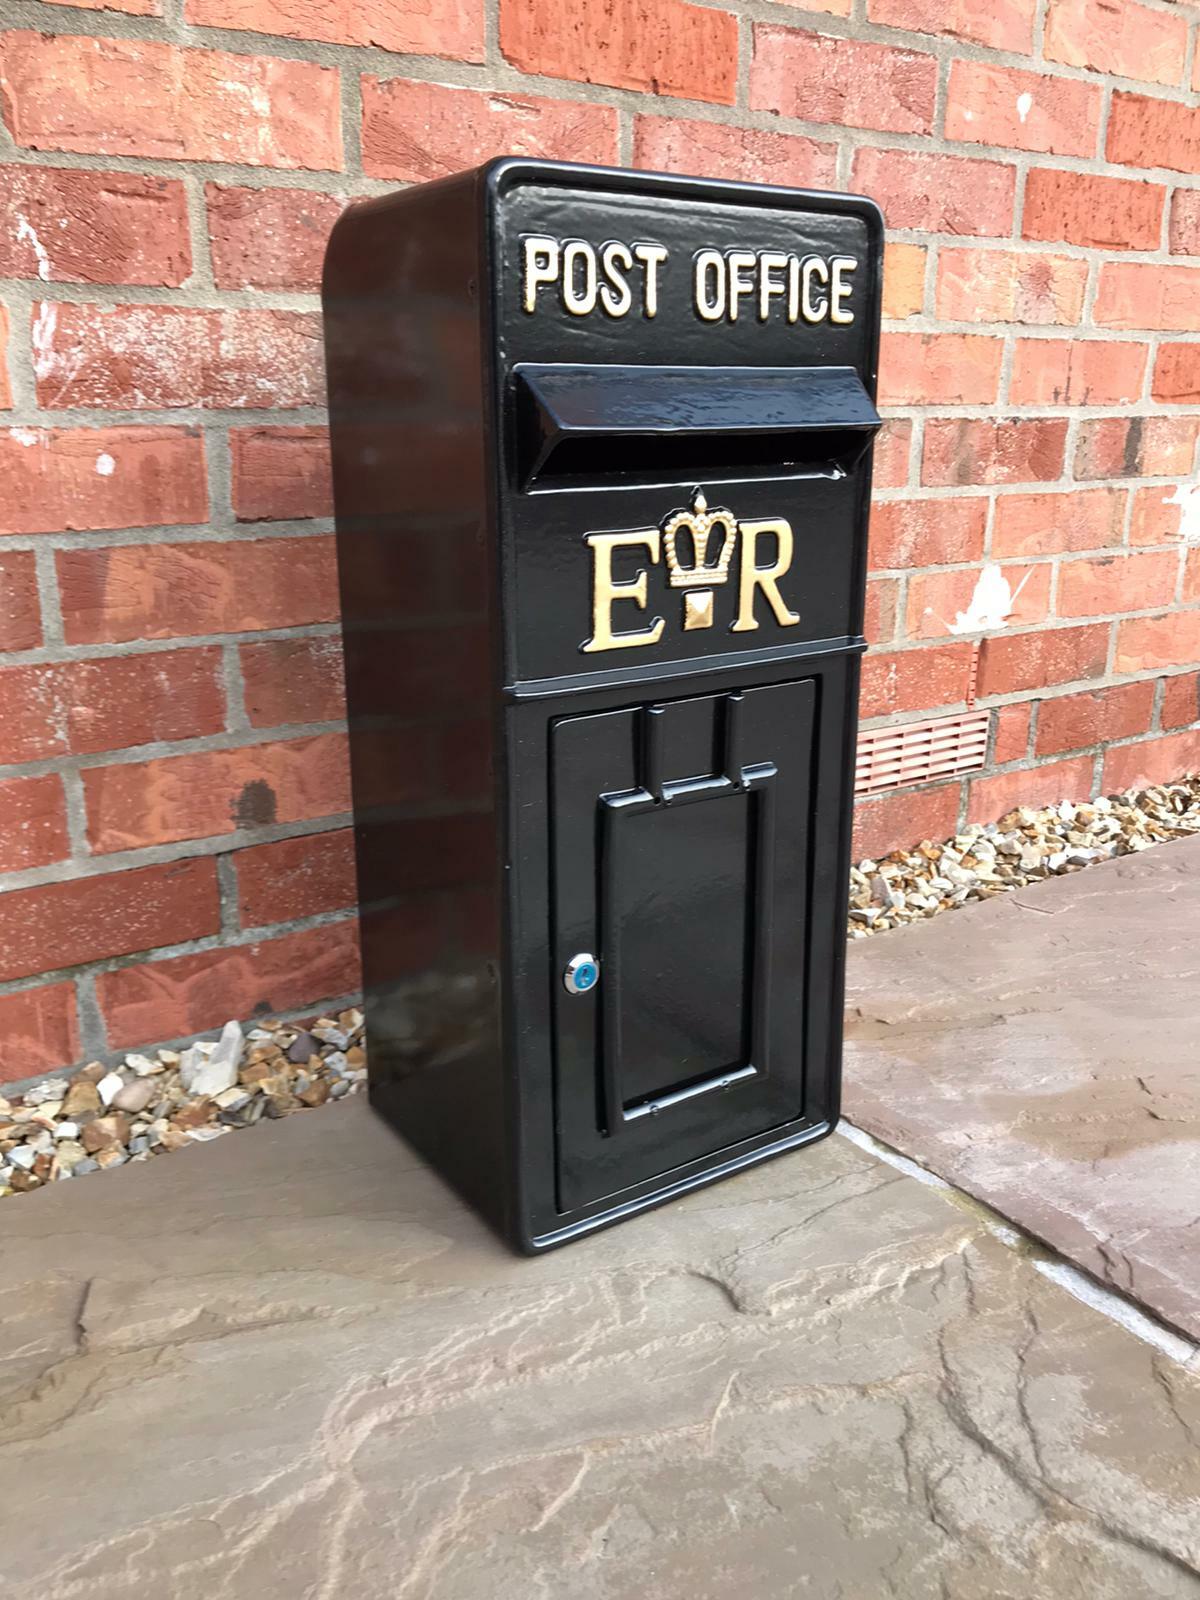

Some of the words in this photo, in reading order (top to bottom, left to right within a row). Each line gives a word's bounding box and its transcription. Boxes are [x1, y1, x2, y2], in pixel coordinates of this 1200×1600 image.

[521, 236, 668, 318] POST
[694, 249, 858, 324] OFFICE
[582, 529, 666, 652] E
[730, 519, 801, 632] R
